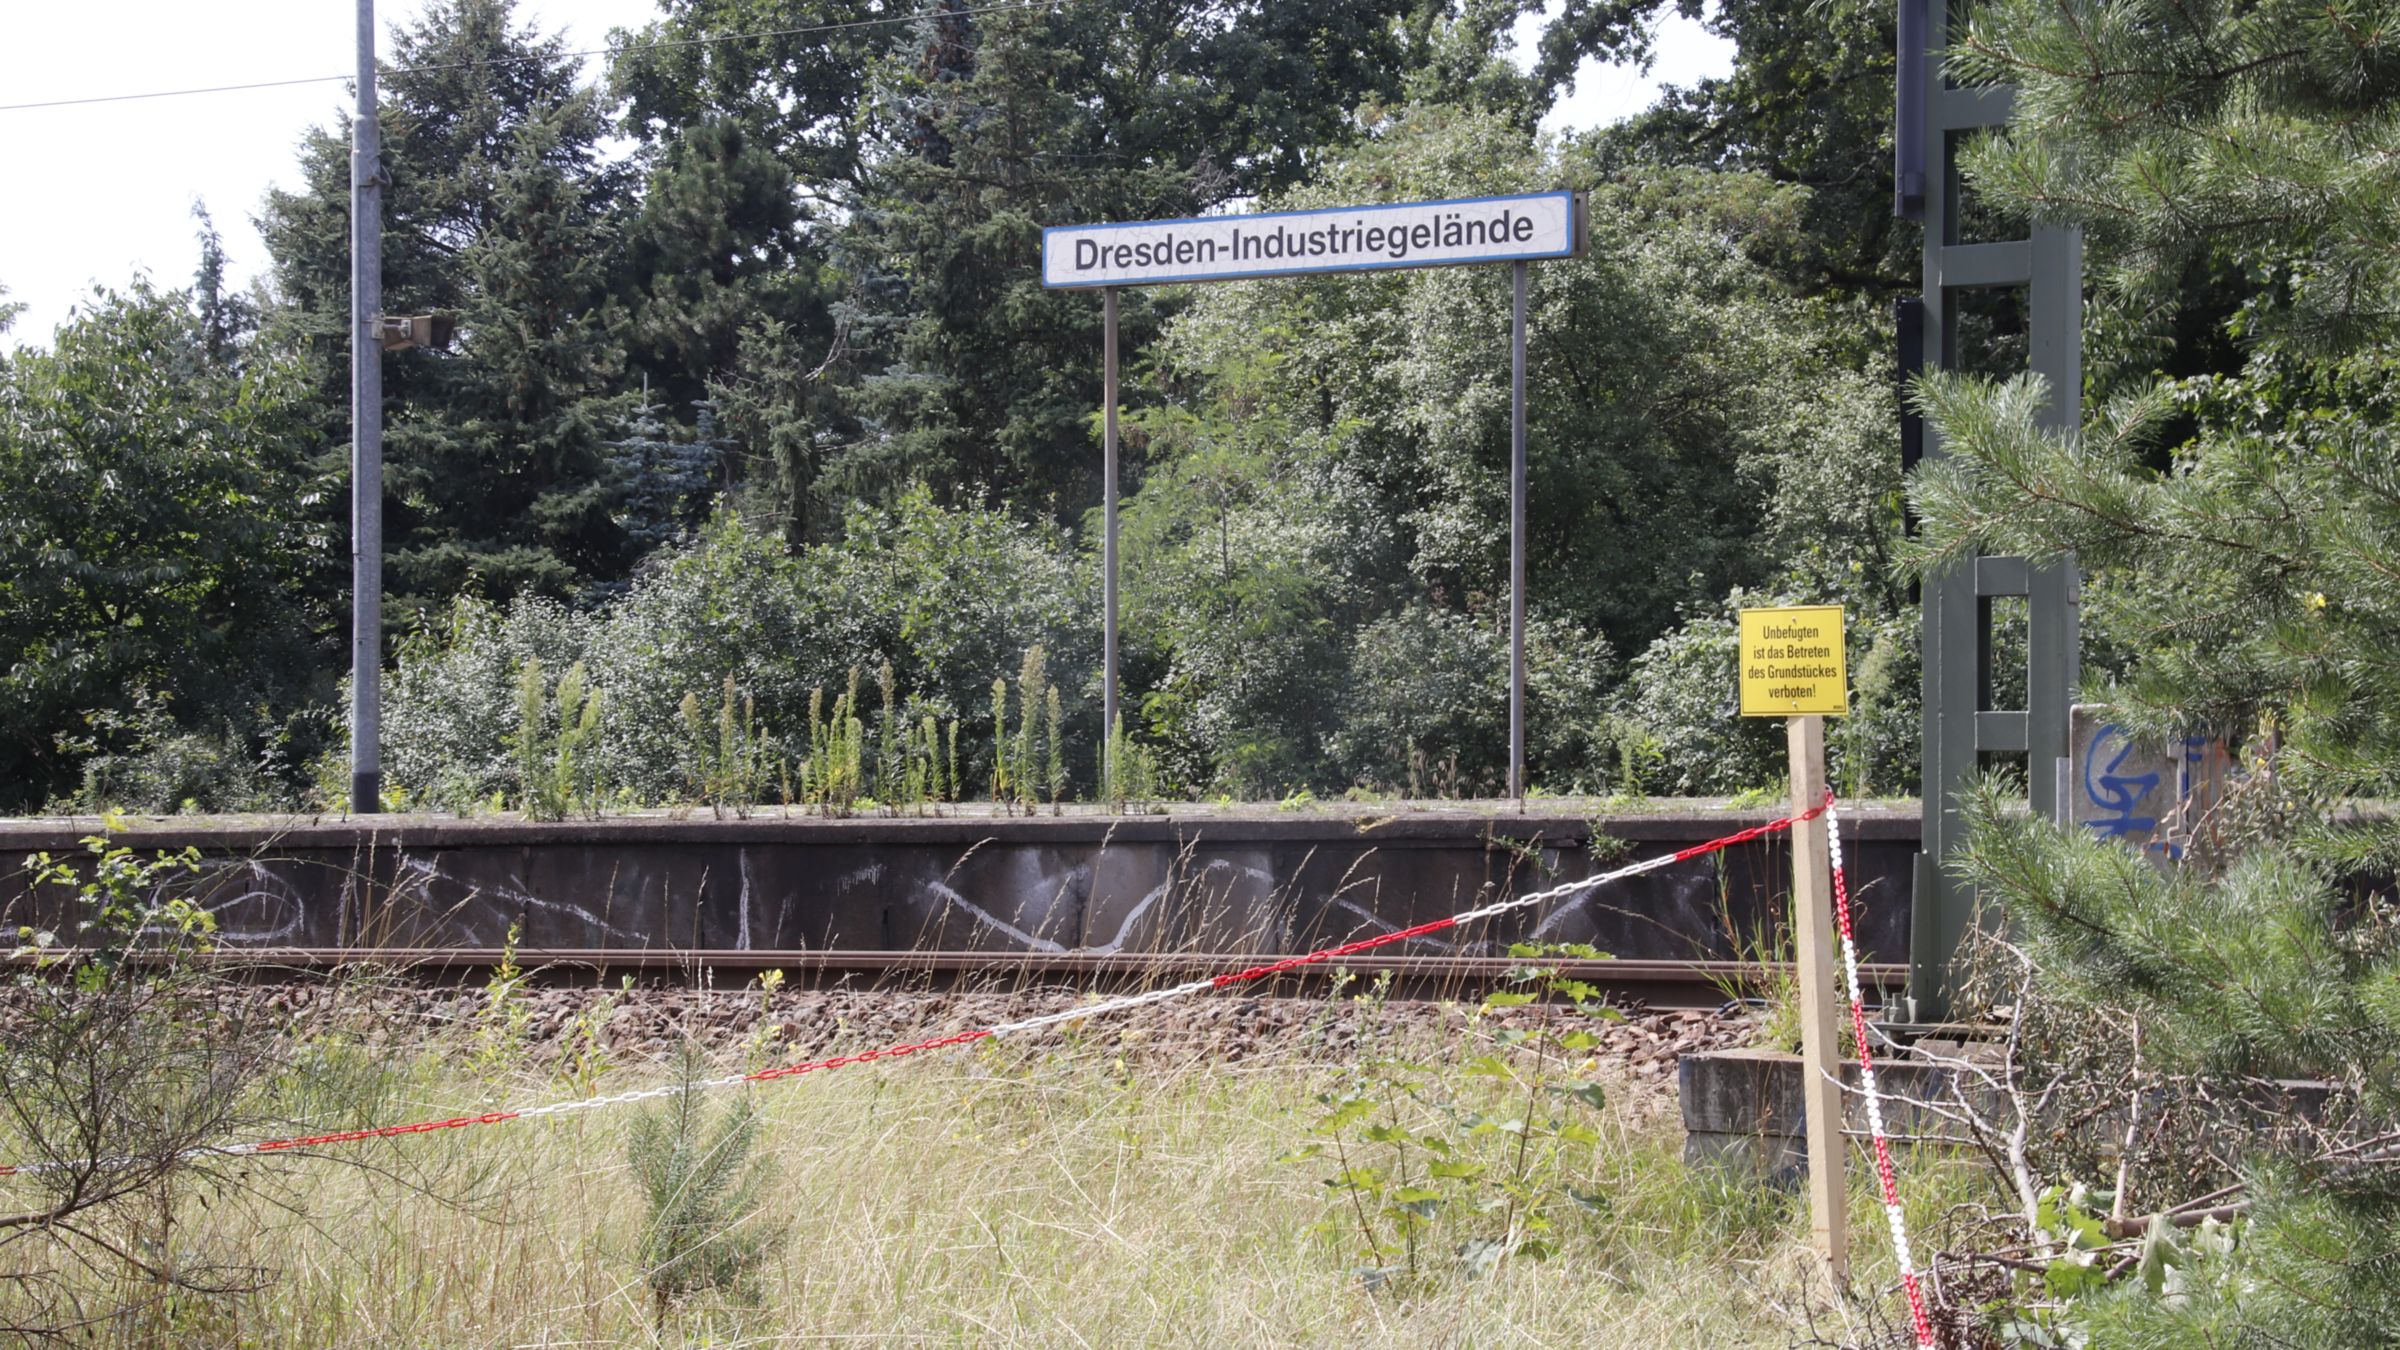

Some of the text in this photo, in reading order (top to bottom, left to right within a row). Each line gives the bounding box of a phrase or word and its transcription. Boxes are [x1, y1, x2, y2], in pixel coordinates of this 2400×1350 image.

[1075, 209, 1534, 271] Dresden-Industriegelände
[1763, 625, 1819, 642] Unbefugten
[1753, 645, 1830, 659] ist das Betreten
[1748, 664, 1837, 679] des Grundstückes
[1768, 684, 1816, 698] verboten!
